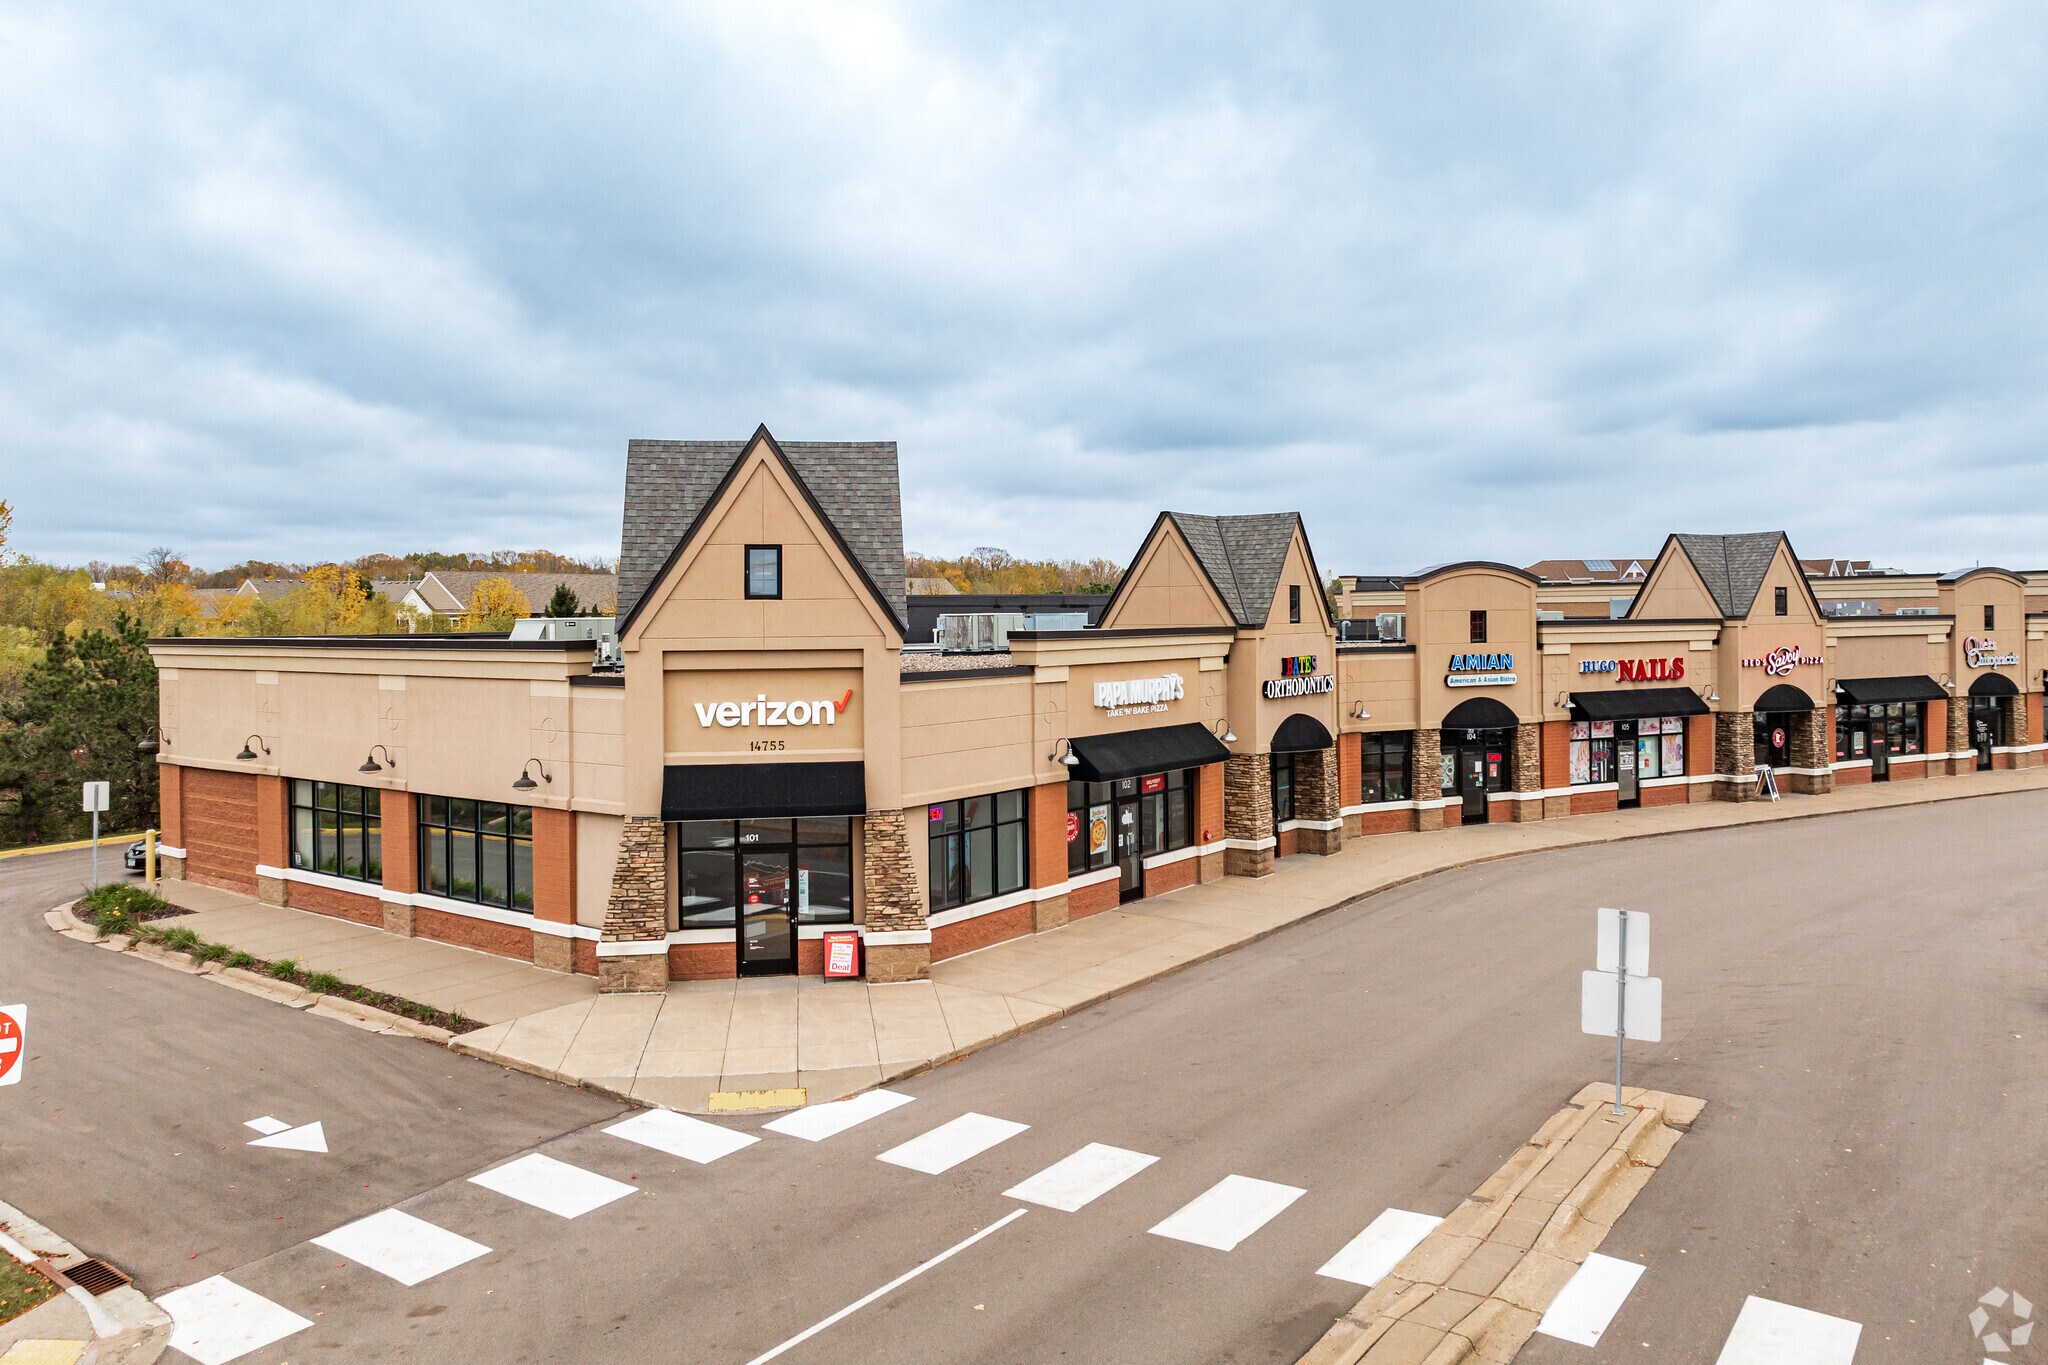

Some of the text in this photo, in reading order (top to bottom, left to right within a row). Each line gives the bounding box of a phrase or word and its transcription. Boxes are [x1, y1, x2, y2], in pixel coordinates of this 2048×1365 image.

[1282, 655, 1317, 675] BATES
[1449, 653, 1514, 671] AMIAN
[1580, 657, 1685, 682] HUGO NAILS
[1743, 659, 1766, 667] RED'S
[1766, 646, 1800, 675] Savoy
[1094, 681, 1128, 709] PAPA
[1266, 675, 1334, 698] ORTHODONTICS
[694, 694, 836, 727] verizon
[1107, 709, 1123, 717] TAKE
[1133, 706, 1149, 714] BAKE
[1151, 704, 1168, 712] PIZZA
[750, 741, 785, 751] 14755
[1122, 780, 1131, 789] 102
[832, 963, 850, 971] Deal
